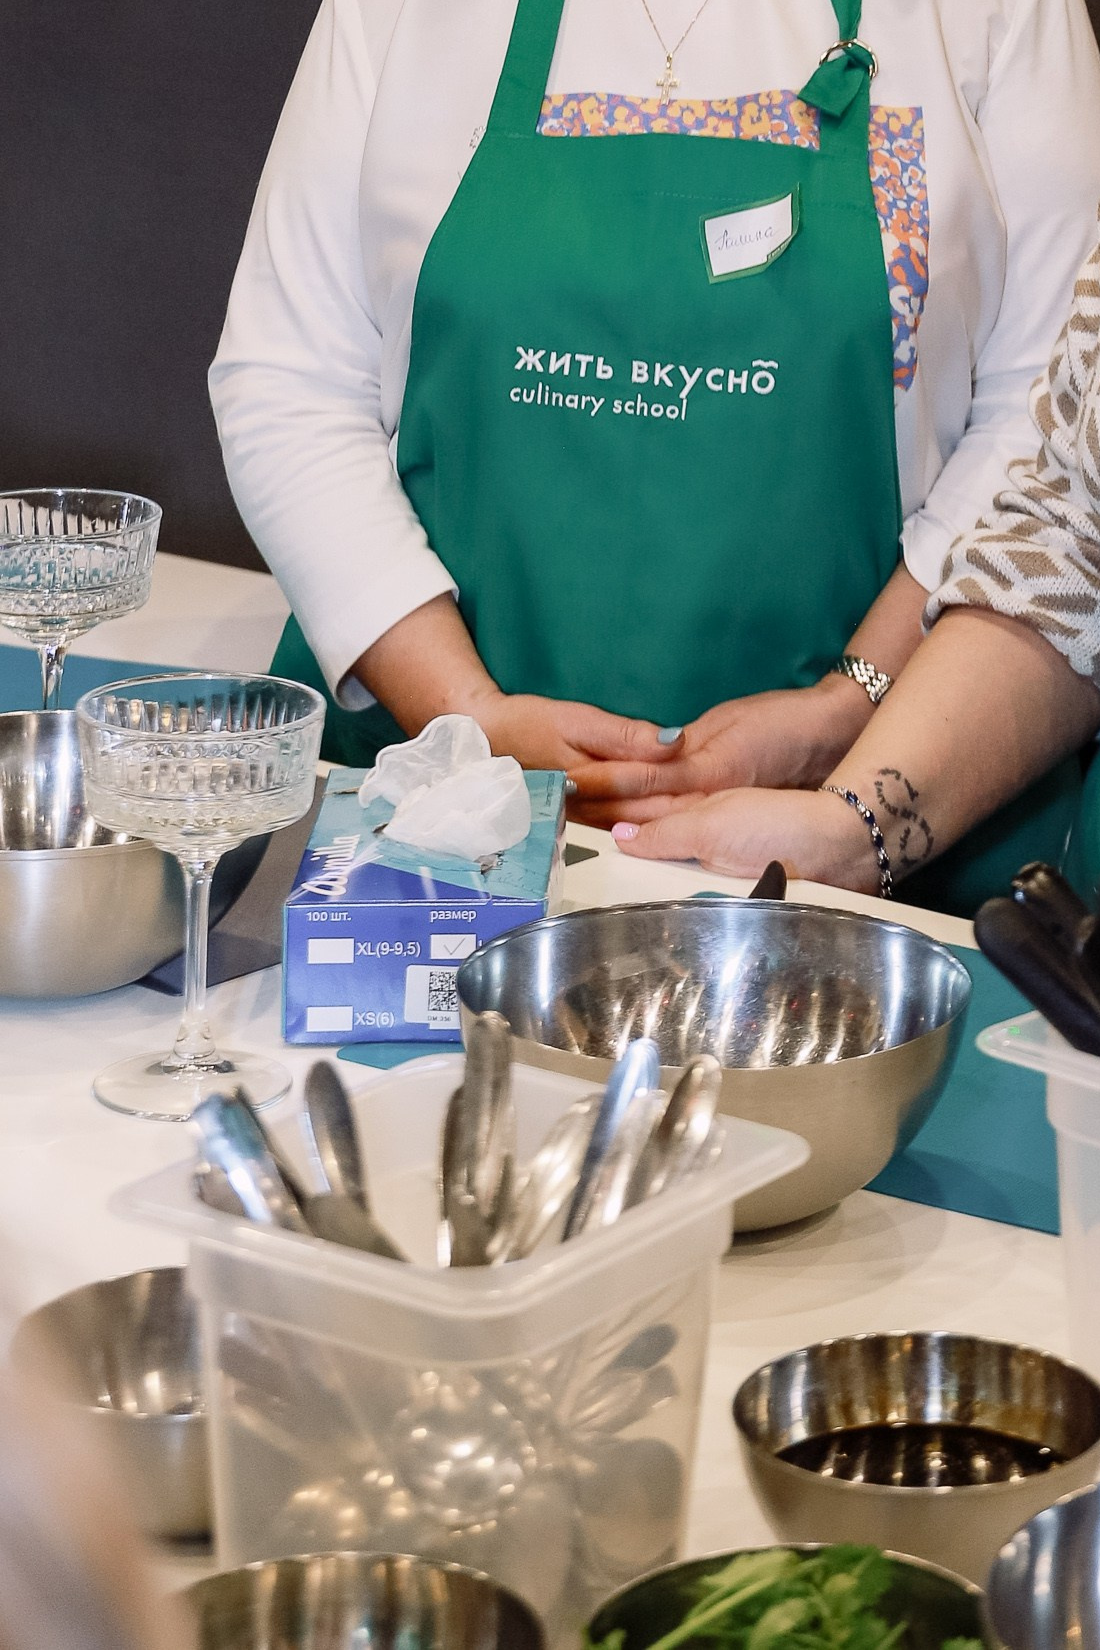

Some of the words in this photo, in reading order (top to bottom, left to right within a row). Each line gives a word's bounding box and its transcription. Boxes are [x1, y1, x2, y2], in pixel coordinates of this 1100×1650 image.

[509, 382, 605, 417] culinary
[612, 394, 687, 421] school
[306, 912, 328, 922] 100
[330, 912, 352, 922] шт.
[430, 910, 477, 923] размер
[355, 941, 421, 959] XL(9-9,5)
[353, 1011, 395, 1029] XS(6)
